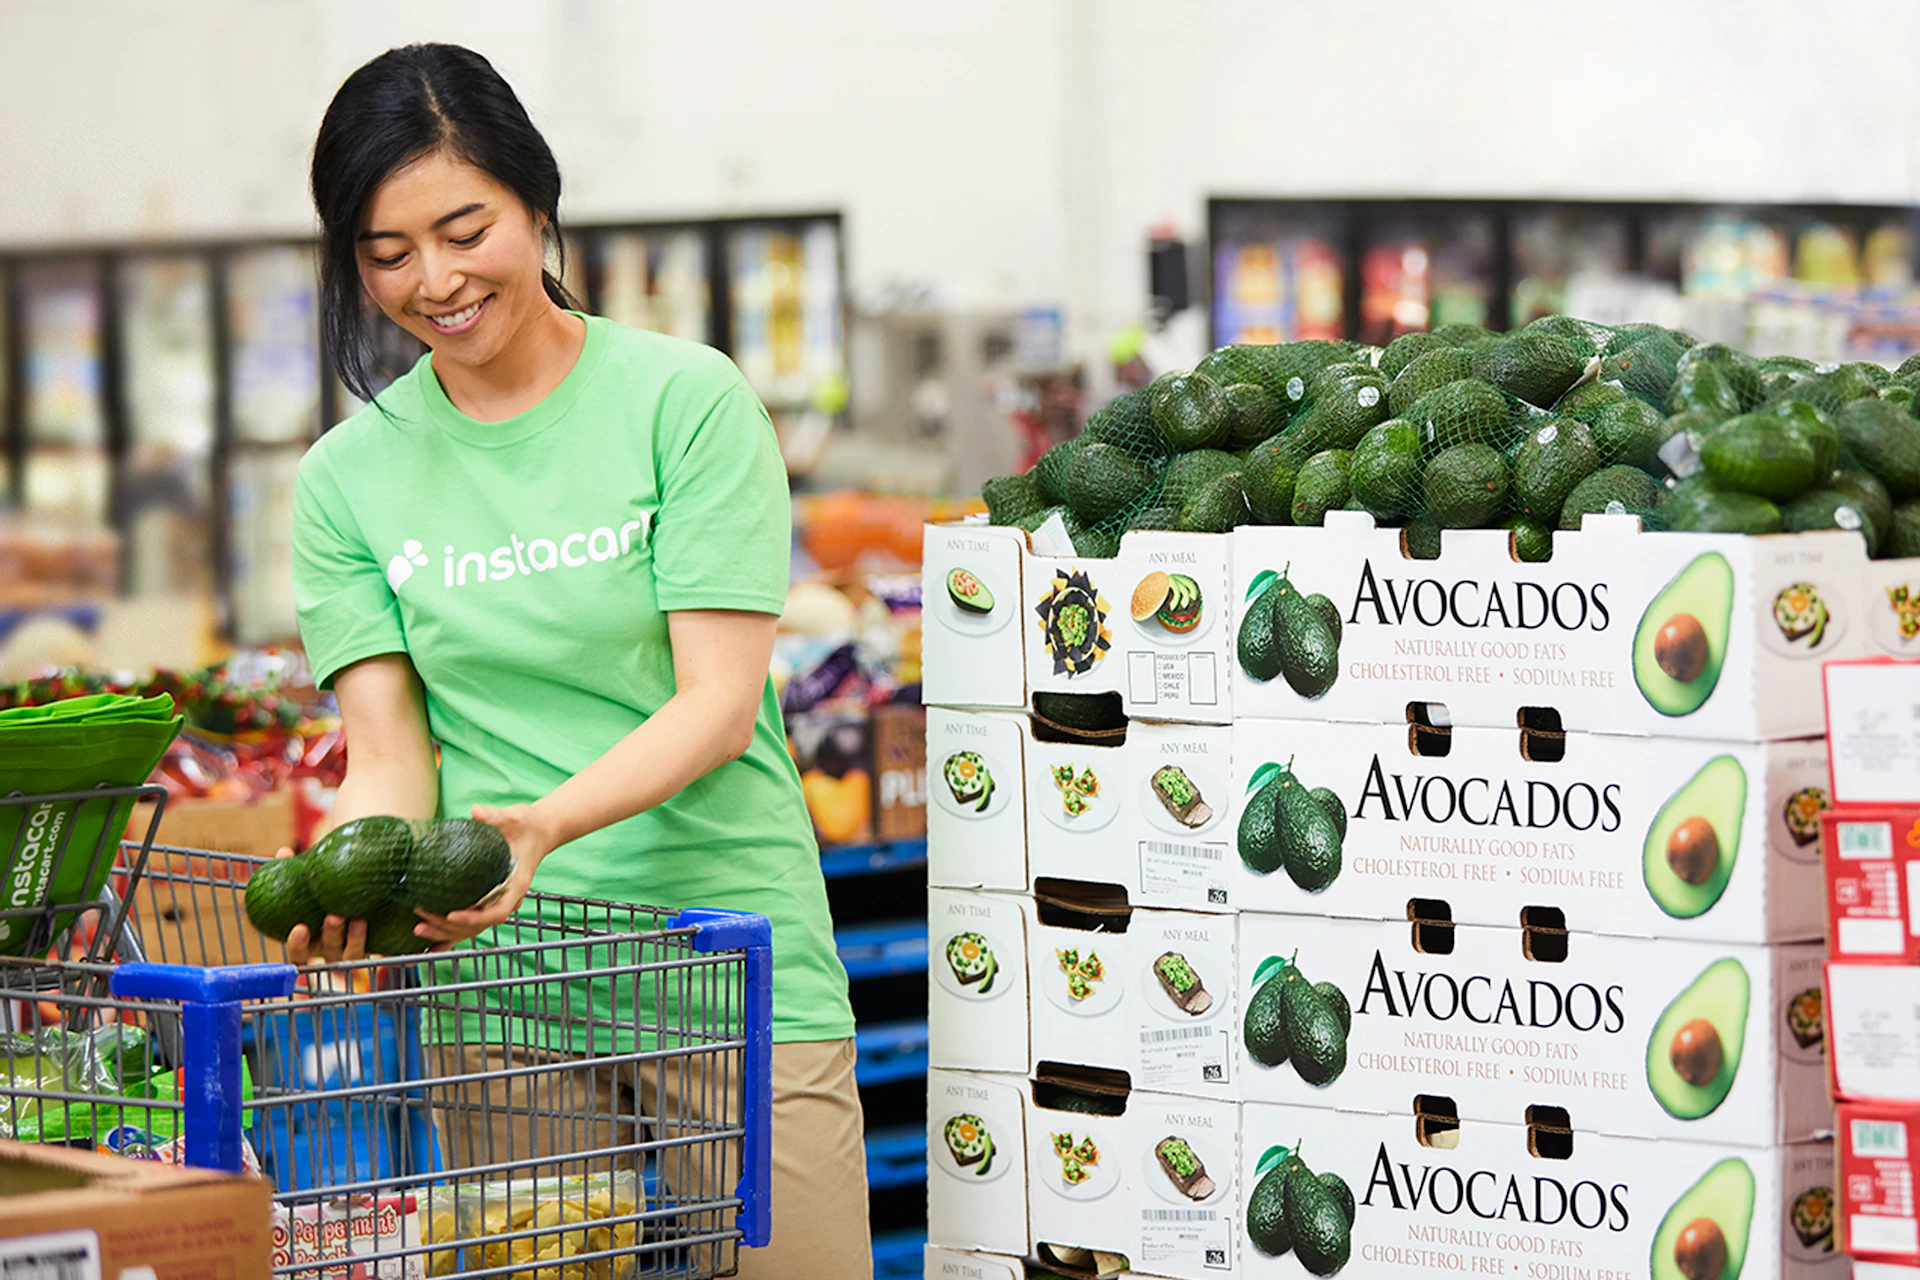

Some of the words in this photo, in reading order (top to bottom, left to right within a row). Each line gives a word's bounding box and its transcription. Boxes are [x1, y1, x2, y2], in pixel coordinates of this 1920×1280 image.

[946, 539, 964, 551] ANY
[967, 540, 991, 553] TIME
[1148, 552, 1170, 563] ANY
[1171, 553, 1197, 564] MEAL
[1346, 558, 1610, 631] AVOCADOS
[1394, 639, 1476, 657] NATURALLY
[1481, 642, 1530, 659] GOOD
[1534, 643, 1568, 659] FATS
[1349, 663, 1453, 683] CHOLESTEROL
[1457, 666, 1490, 684] FREE
[1513, 669, 1577, 686] SODIUM
[1581, 671, 1614, 689] FREE
[944, 723, 962, 735] ANY
[963, 725, 988, 737] TIME
[1159, 743, 1178, 753] ANY
[1179, 743, 1209, 755] MEAL
[1808, 755, 1828, 769] TIM
[1350, 753, 1621, 832] AVOCADOS
[10, 801, 53, 909] nstacar
[32, 811, 66, 907] nstacart.com
[1400, 835, 1484, 855] NATURALLY
[1488, 839, 1540, 858] GOOD
[1543, 842, 1576, 859] FATS
[1352, 857, 1458, 880] CHOLESTEROL
[1463, 863, 1497, 881] FREE
[1520, 868, 1585, 887] SODIUM
[1590, 871, 1623, 889] FREE
[947, 904, 966, 916] ANY
[968, 905, 992, 918] TIME
[1161, 930, 1182, 941] ANY
[1182, 930, 1210, 942] MEAL
[1354, 949, 1625, 1033] AVOCADOS
[1404, 1032, 1486, 1053] NATURALLY
[1491, 1039, 1542, 1057] GOOD
[1545, 1043, 1580, 1059] FATS
[1357, 1053, 1462, 1077] CHOLESTEROL
[1467, 1062, 1499, 1080] FREE
[1523, 1067, 1589, 1087] SODIUM
[1593, 1071, 1626, 1090] FREE
[944, 1085, 964, 1098] ANY
[965, 1087, 989, 1100] TIME
[1164, 1114, 1185, 1126] ANY
[1186, 1117, 1214, 1129] MEAL
[1815, 1157, 1834, 1170] TIM
[1359, 1141, 1629, 1232] AVOCADOS
[1408, 1225, 1491, 1248] NATURALLY
[1495, 1235, 1546, 1254] GOOD
[1550, 1239, 1584, 1257] FATS
[941, 1263, 960, 1276] ANY
[960, 1265, 983, 1280] TIME
[1361, 1243, 1467, 1271] CHOLESTEROL
[1471, 1255, 1505, 1275] FREE
[1527, 1264, 1592, 1280] SODIUM
